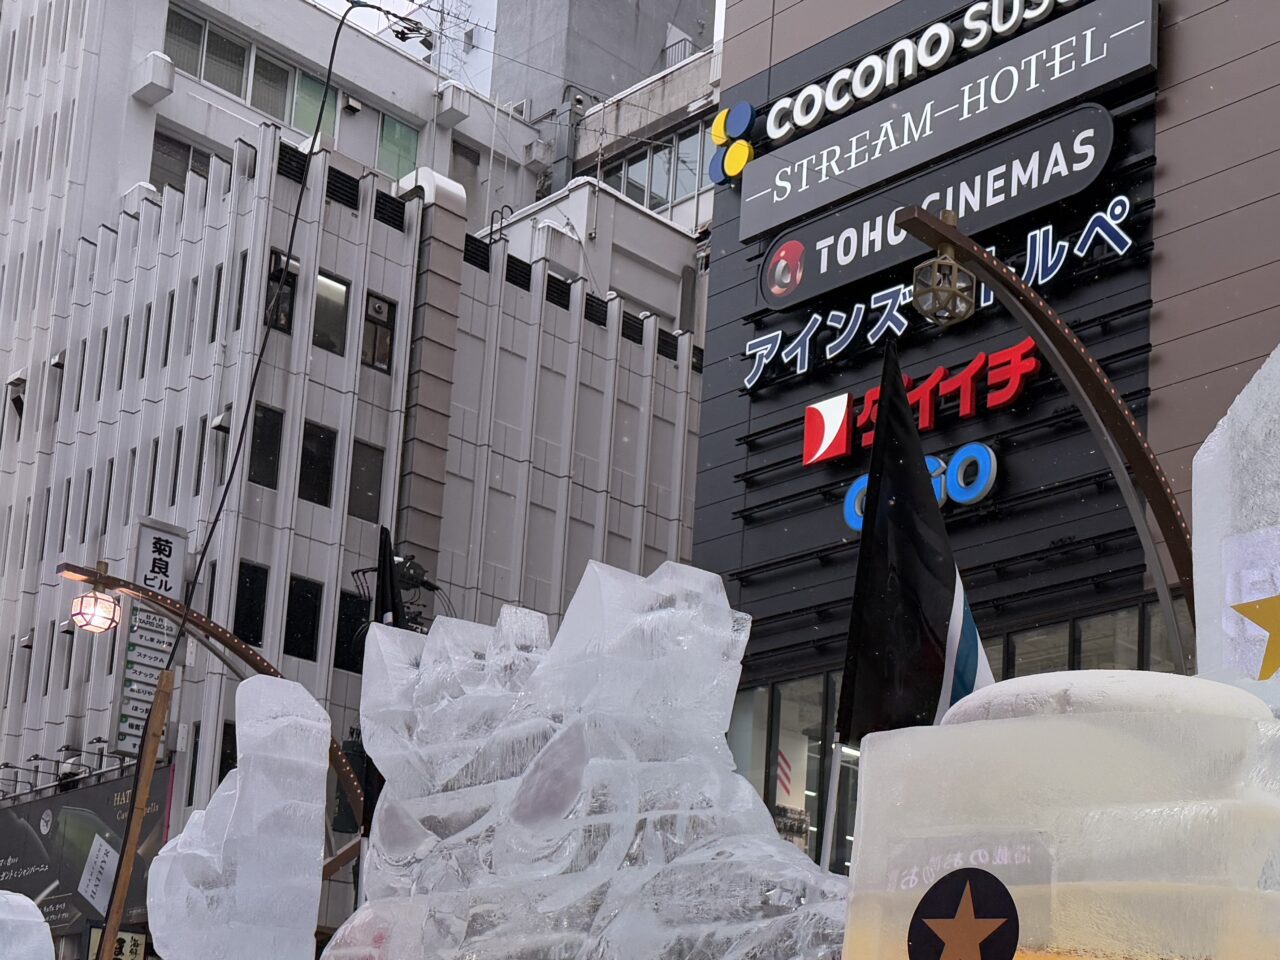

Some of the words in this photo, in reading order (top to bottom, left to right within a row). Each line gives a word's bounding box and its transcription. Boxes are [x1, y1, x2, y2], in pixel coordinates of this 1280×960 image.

[772, 100, 936, 204] STREAM
[957, 27, 1109, 122] HOTEL
[816, 205, 911, 275] TOHO
